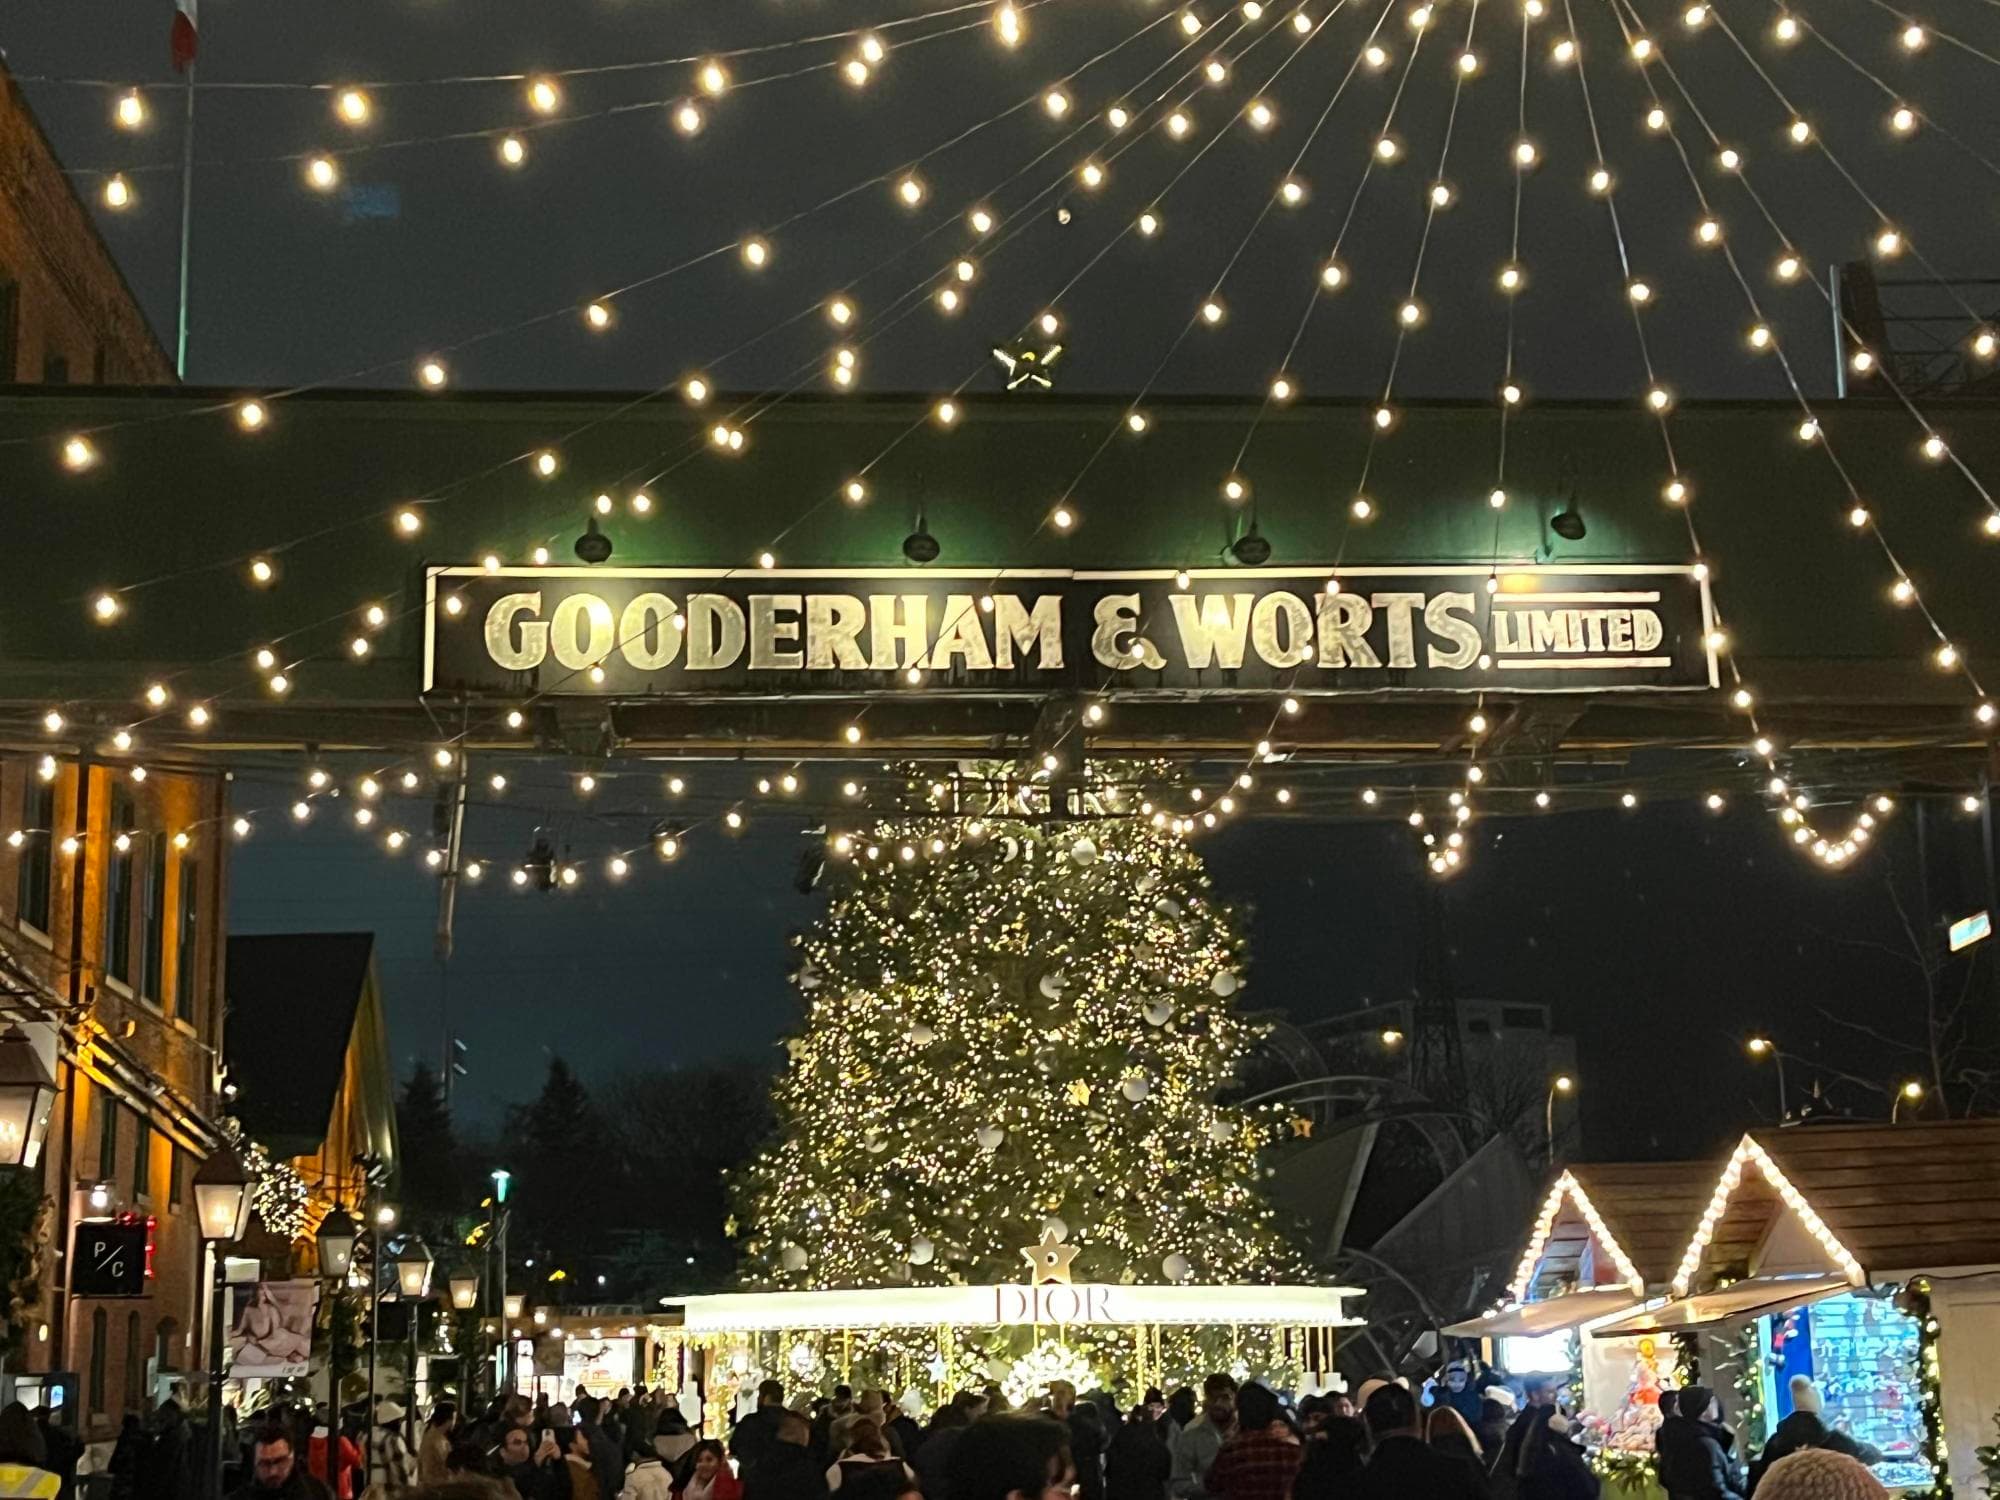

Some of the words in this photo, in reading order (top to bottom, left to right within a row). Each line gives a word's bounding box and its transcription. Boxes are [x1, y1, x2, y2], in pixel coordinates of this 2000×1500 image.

[484, 591, 1064, 671] GOODERHAM
[1092, 592, 1167, 671] &
[1168, 591, 1483, 671] WORTS
[1491, 608, 1662, 654] LIMITED
[996, 1287, 1116, 1322] DIOR
